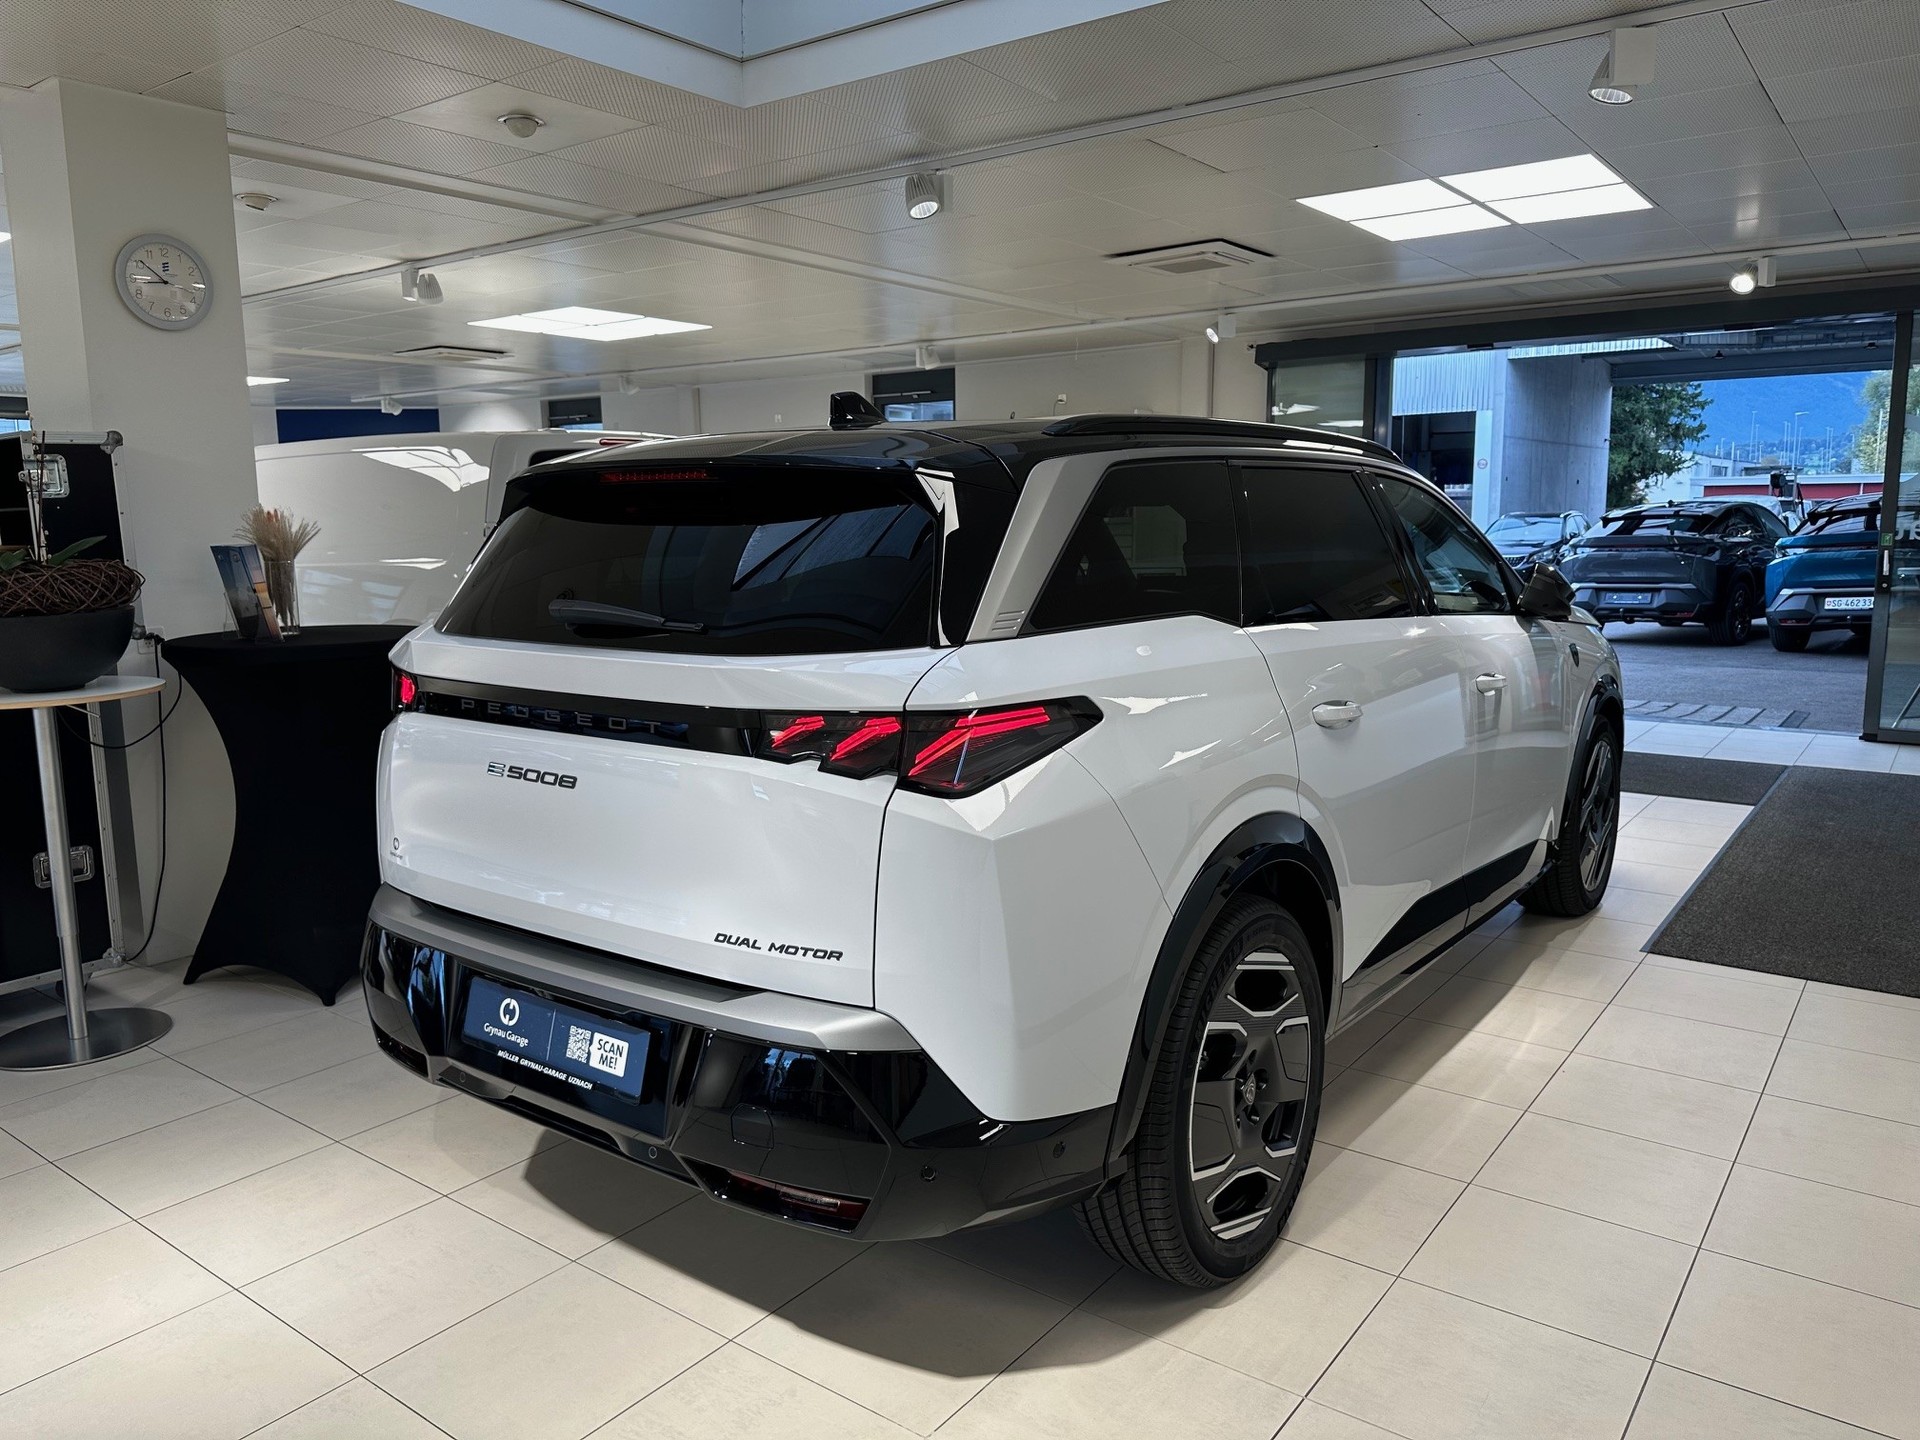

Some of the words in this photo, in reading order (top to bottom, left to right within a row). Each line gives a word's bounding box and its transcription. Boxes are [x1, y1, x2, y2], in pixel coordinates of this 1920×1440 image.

[145, 249, 153, 260] 11
[160, 247, 169, 258] 12
[133, 259, 144, 270] 10
[188, 266, 195, 277] 2
[129, 272, 137, 283] 9
[135, 288, 143, 300] 8
[149, 301, 155, 311] 7
[190, 296, 197, 305] 4
[164, 307, 172, 318] 6
[180, 304, 187, 315] 5
[1831, 599, 1843, 608] SG
[461, 698, 661, 734] PEUGEOT
[713, 932, 762, 951] DUAL
[767, 942, 844, 962] MOTOR
[483, 1022, 508, 1039] Grynau
[506, 1031, 529, 1048] Garage
[597, 1038, 624, 1058] SCAN
[598, 1053, 618, 1070] ME!
[497, 1049, 520, 1063] MÜLLER
[519, 1058, 568, 1081] GRYNAU-GARAGE
[567, 1075, 594, 1090] UZNACH
